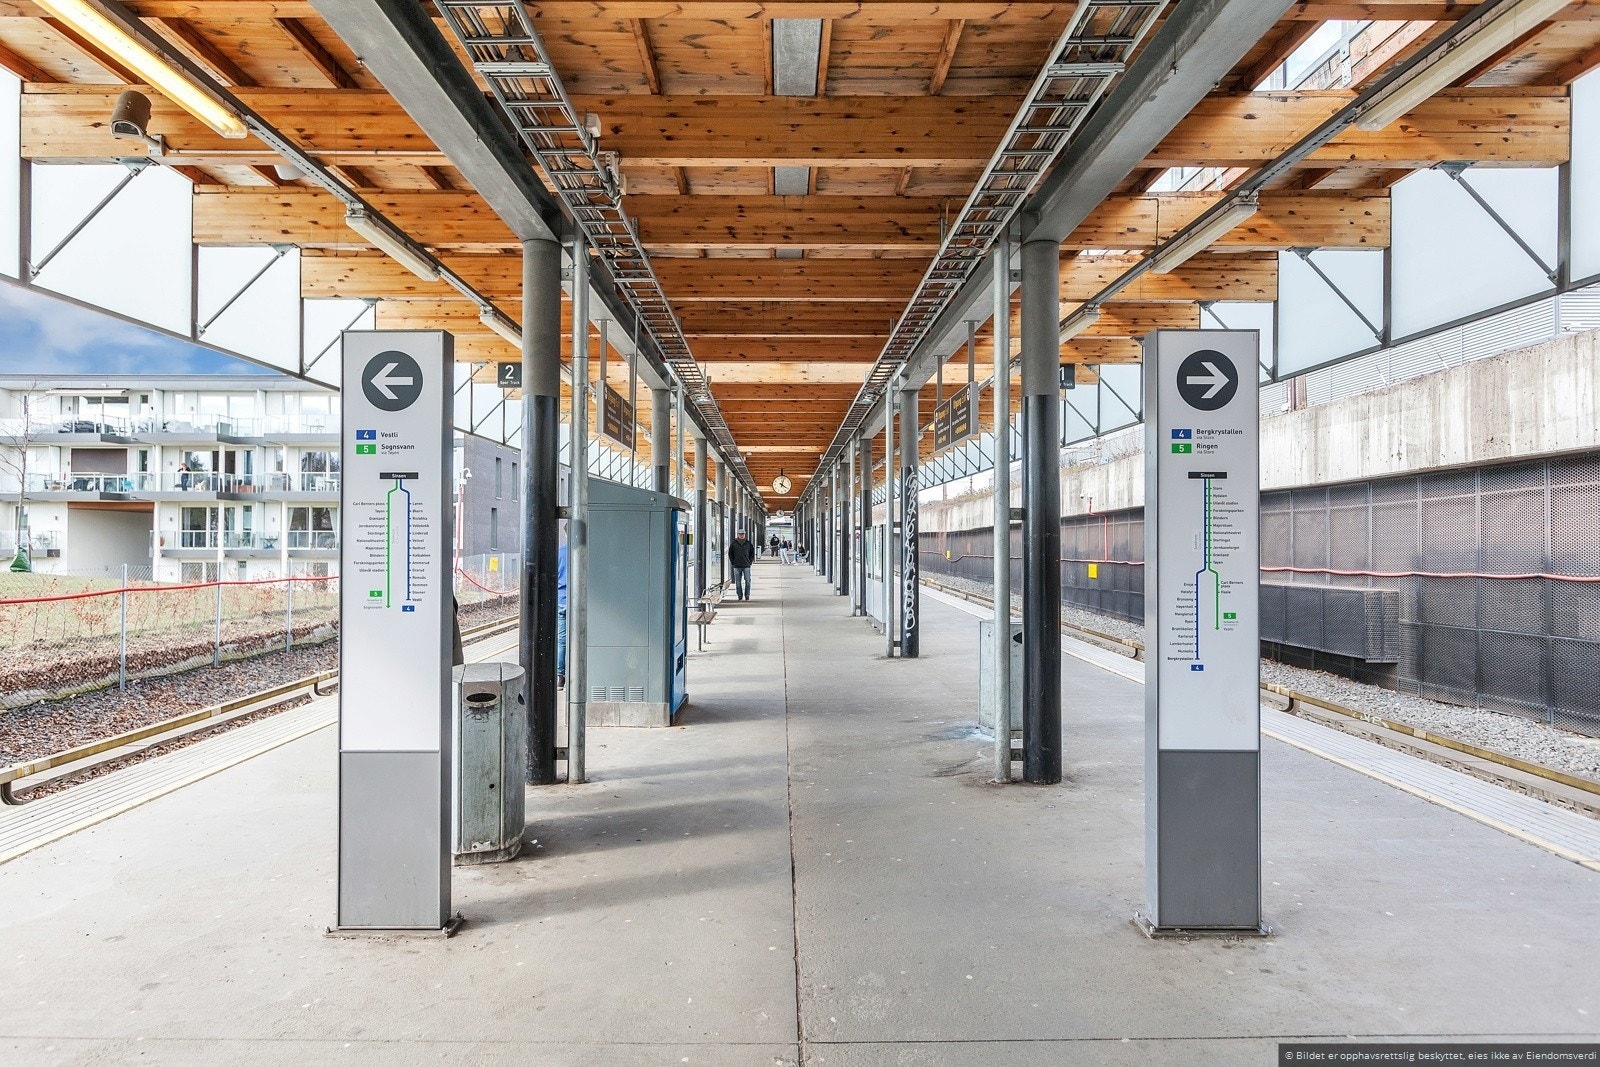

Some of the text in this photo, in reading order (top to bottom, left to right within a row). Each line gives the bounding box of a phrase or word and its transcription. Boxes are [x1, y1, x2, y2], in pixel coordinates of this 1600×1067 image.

[505, 364, 514, 380] 2
[1059, 366, 1064, 380] 1
[364, 431, 369, 439] 4
